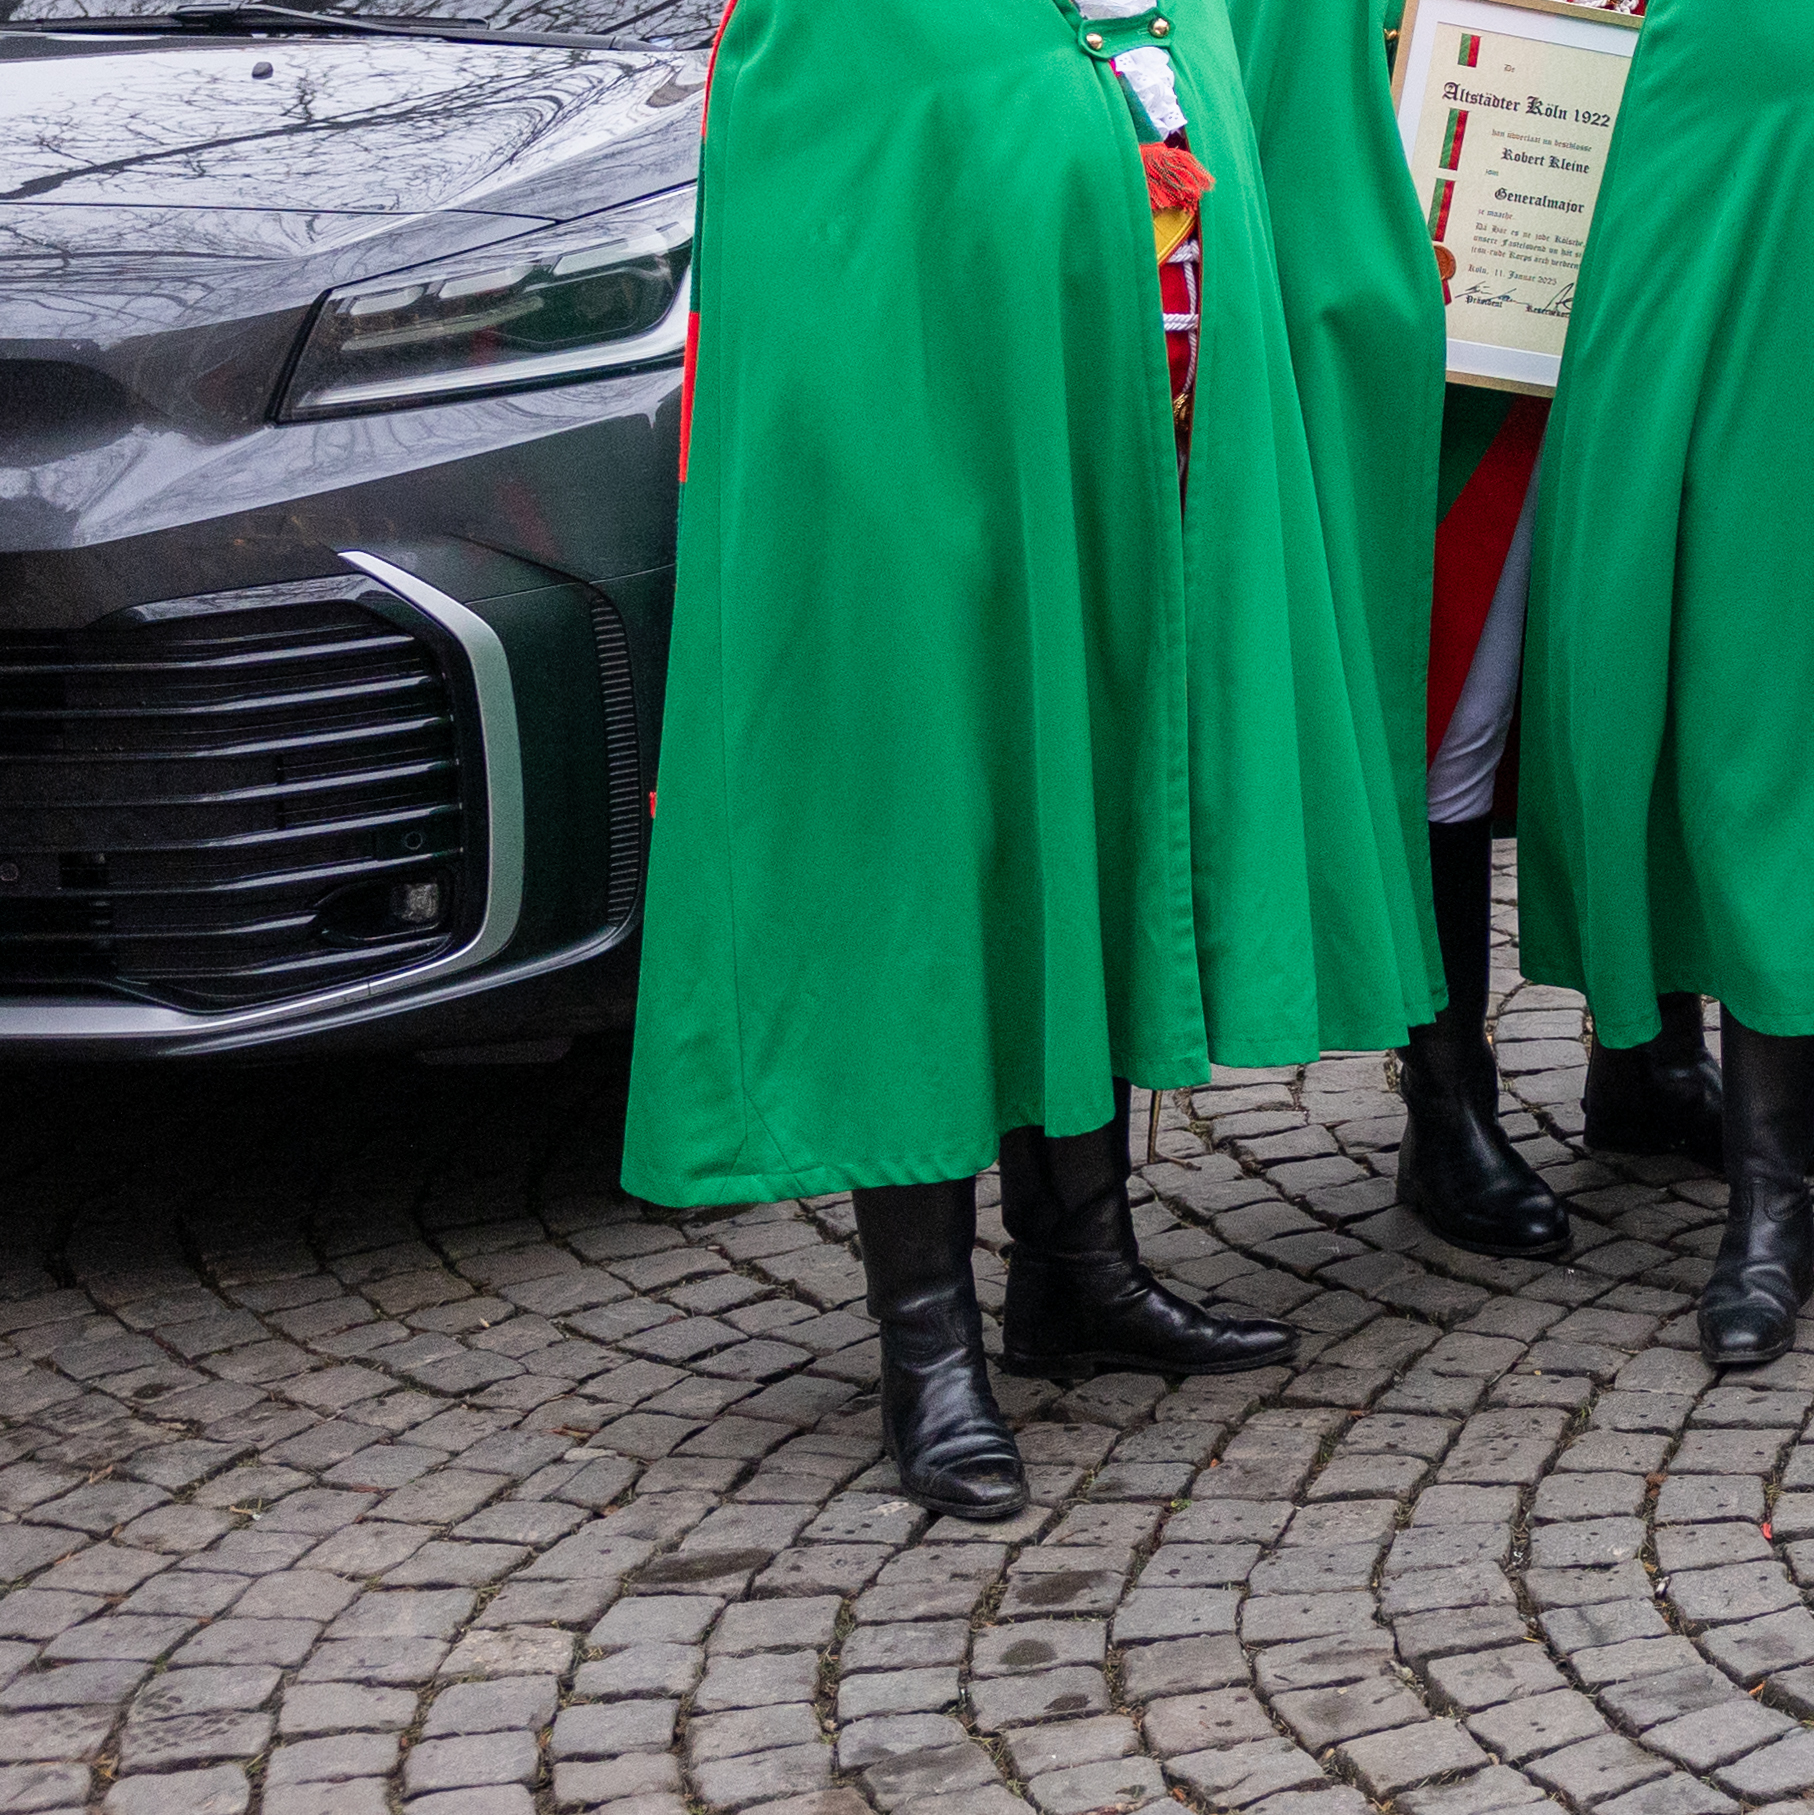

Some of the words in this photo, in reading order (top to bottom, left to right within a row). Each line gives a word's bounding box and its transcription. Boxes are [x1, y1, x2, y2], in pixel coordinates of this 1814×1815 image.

[1443, 82, 1520, 111] Altstädter
[1526, 96, 1567, 120] Köln
[1575, 109, 1610, 127] 1922
[1502, 148, 1544, 166] Robert
[1549, 156, 1589, 173] Kleine
[1495, 188, 1584, 213] Generalmajor
